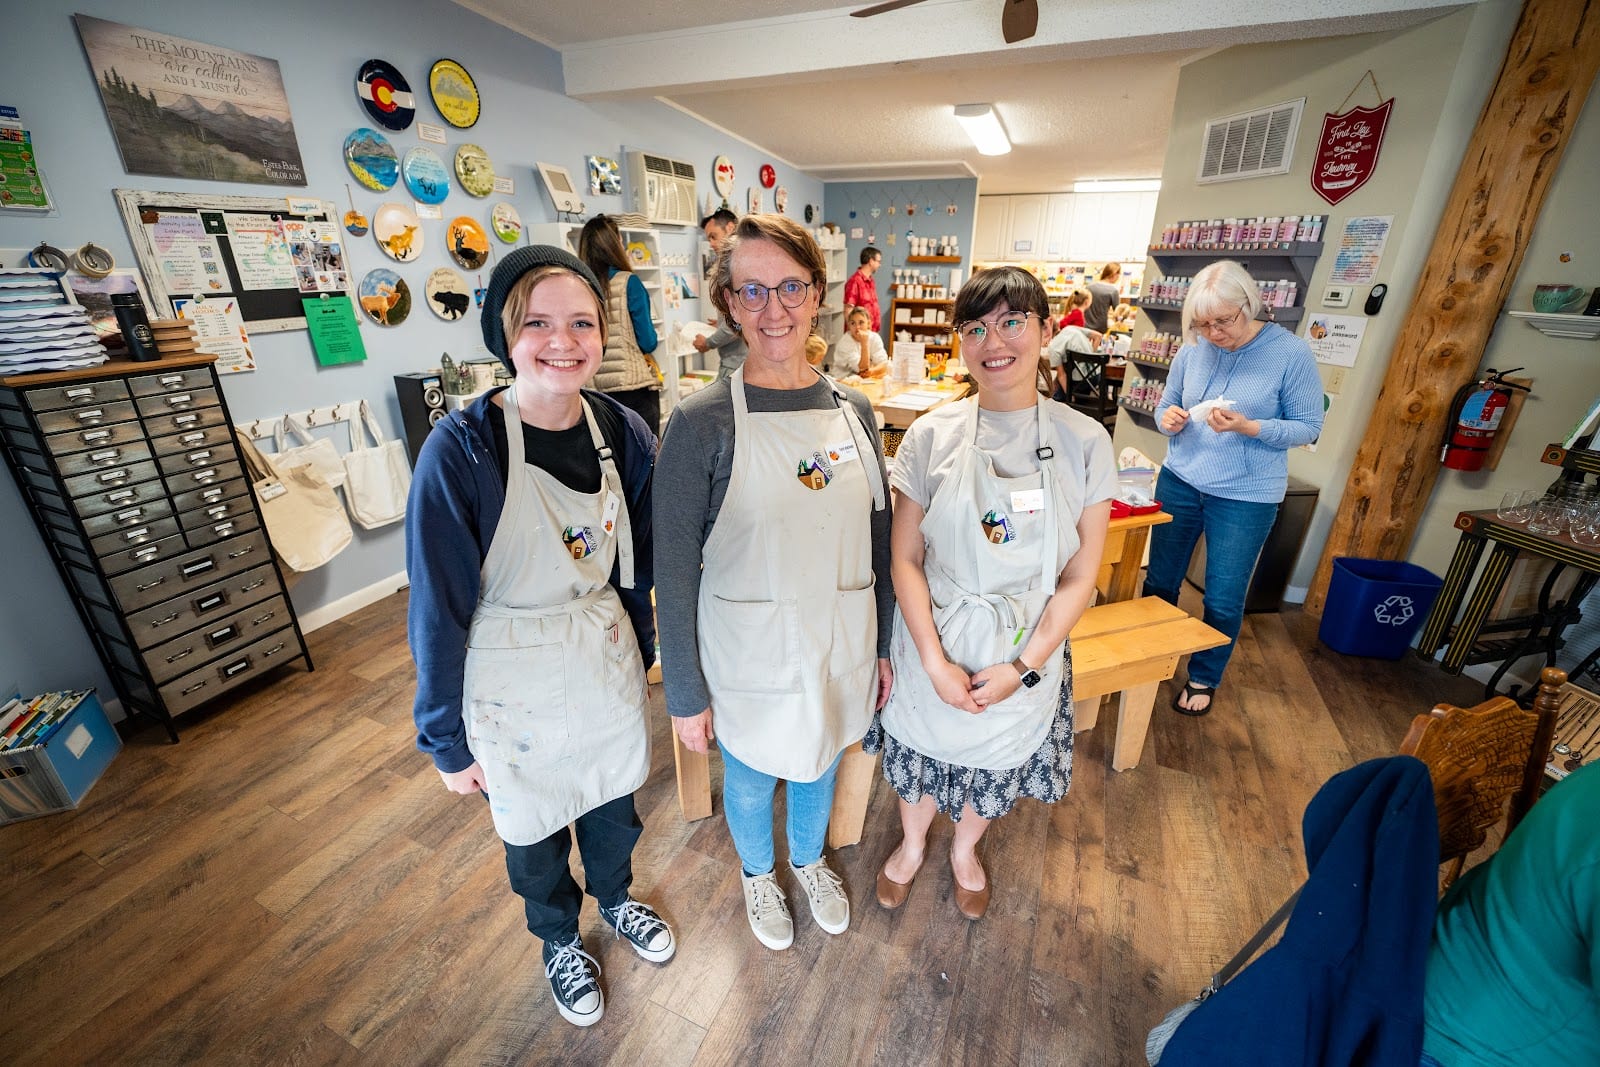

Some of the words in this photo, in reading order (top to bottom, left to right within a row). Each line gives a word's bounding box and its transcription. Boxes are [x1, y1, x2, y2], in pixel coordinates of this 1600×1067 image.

[131, 35, 168, 54] THE
[172, 44, 259, 73] MOUNTAINS
[163, 60, 189, 73] are
[195, 63, 241, 92] calling
[163, 74, 188, 86] AND
[191, 79, 197, 87] I
[200, 81, 231, 92] MUST
[1327, 121, 1352, 145] Find
[1350, 121, 1373, 139] Joy
[1320, 161, 1364, 178] Journey
